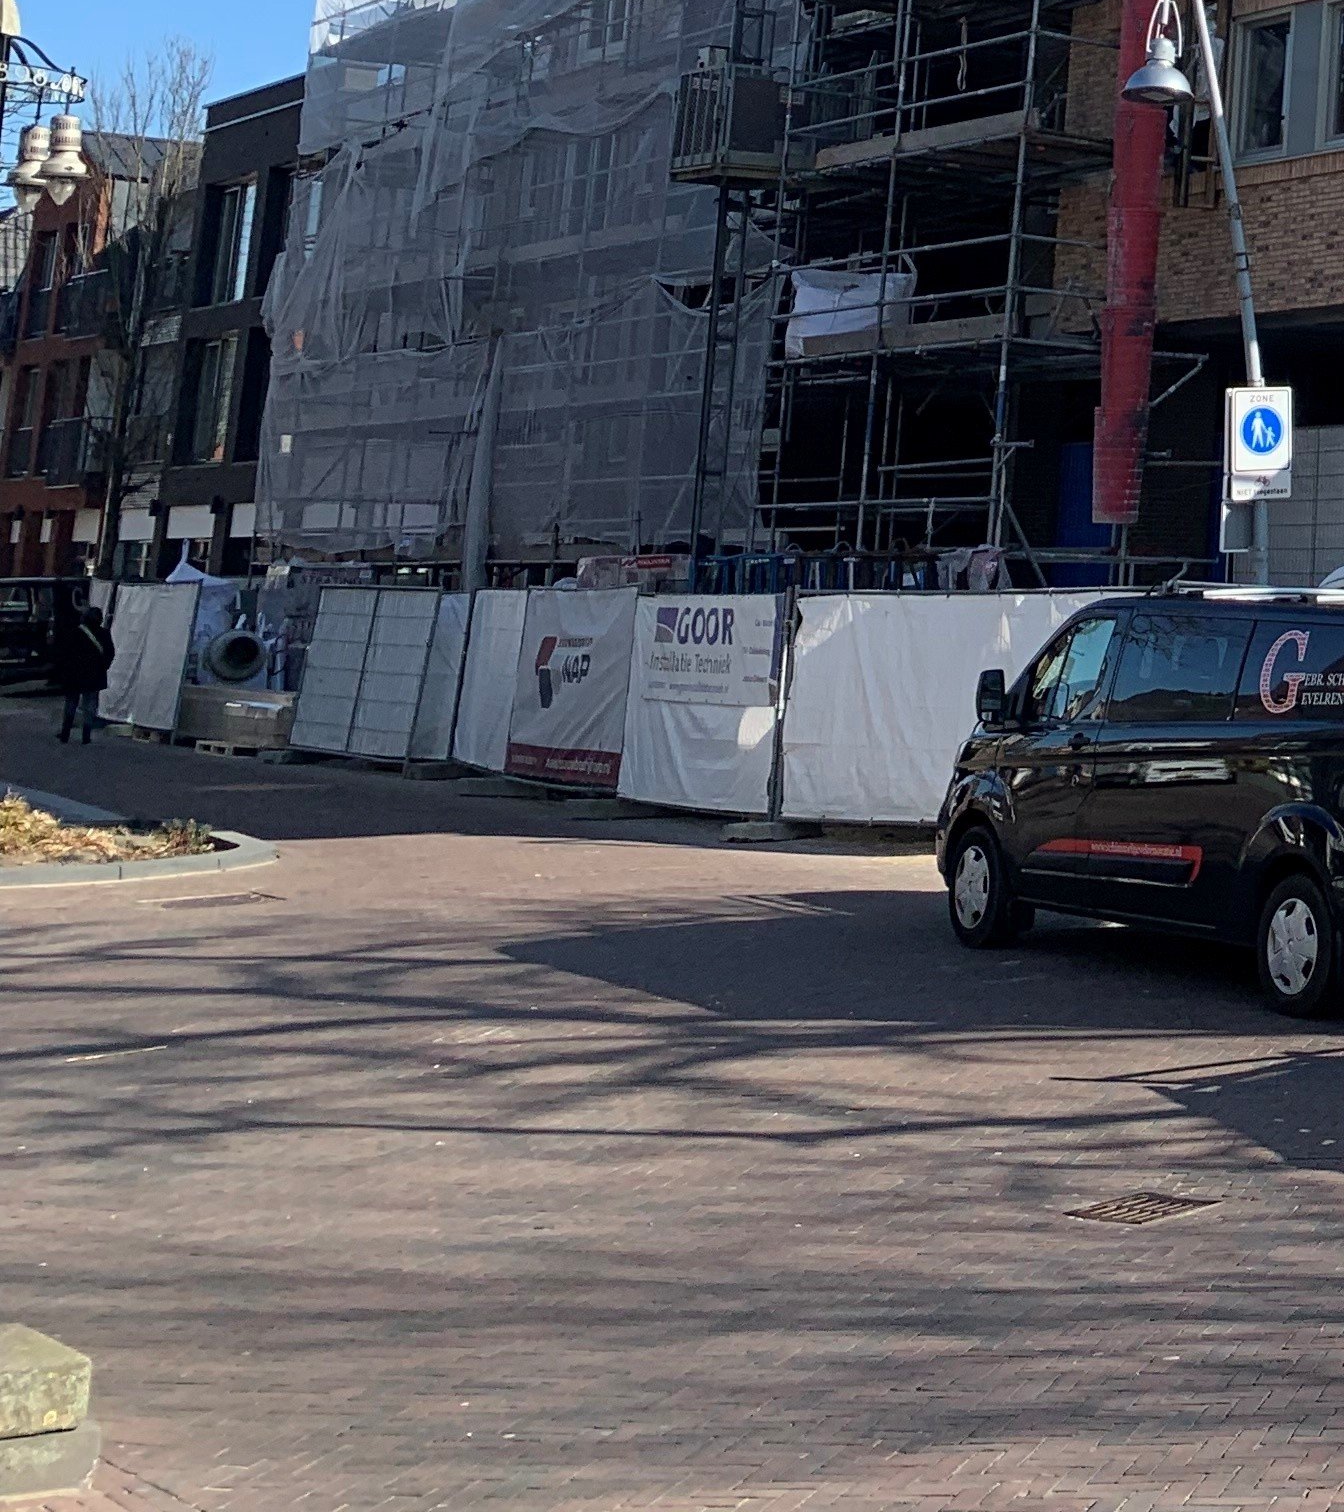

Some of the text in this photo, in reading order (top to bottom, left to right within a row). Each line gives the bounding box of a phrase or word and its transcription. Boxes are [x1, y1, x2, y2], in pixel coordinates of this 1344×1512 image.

[1249, 394, 1275, 403] ZONE
[677, 606, 735, 645] GOOR
[562, 654, 591, 683] NAP
[650, 650, 732, 674] Installatie Techniek
